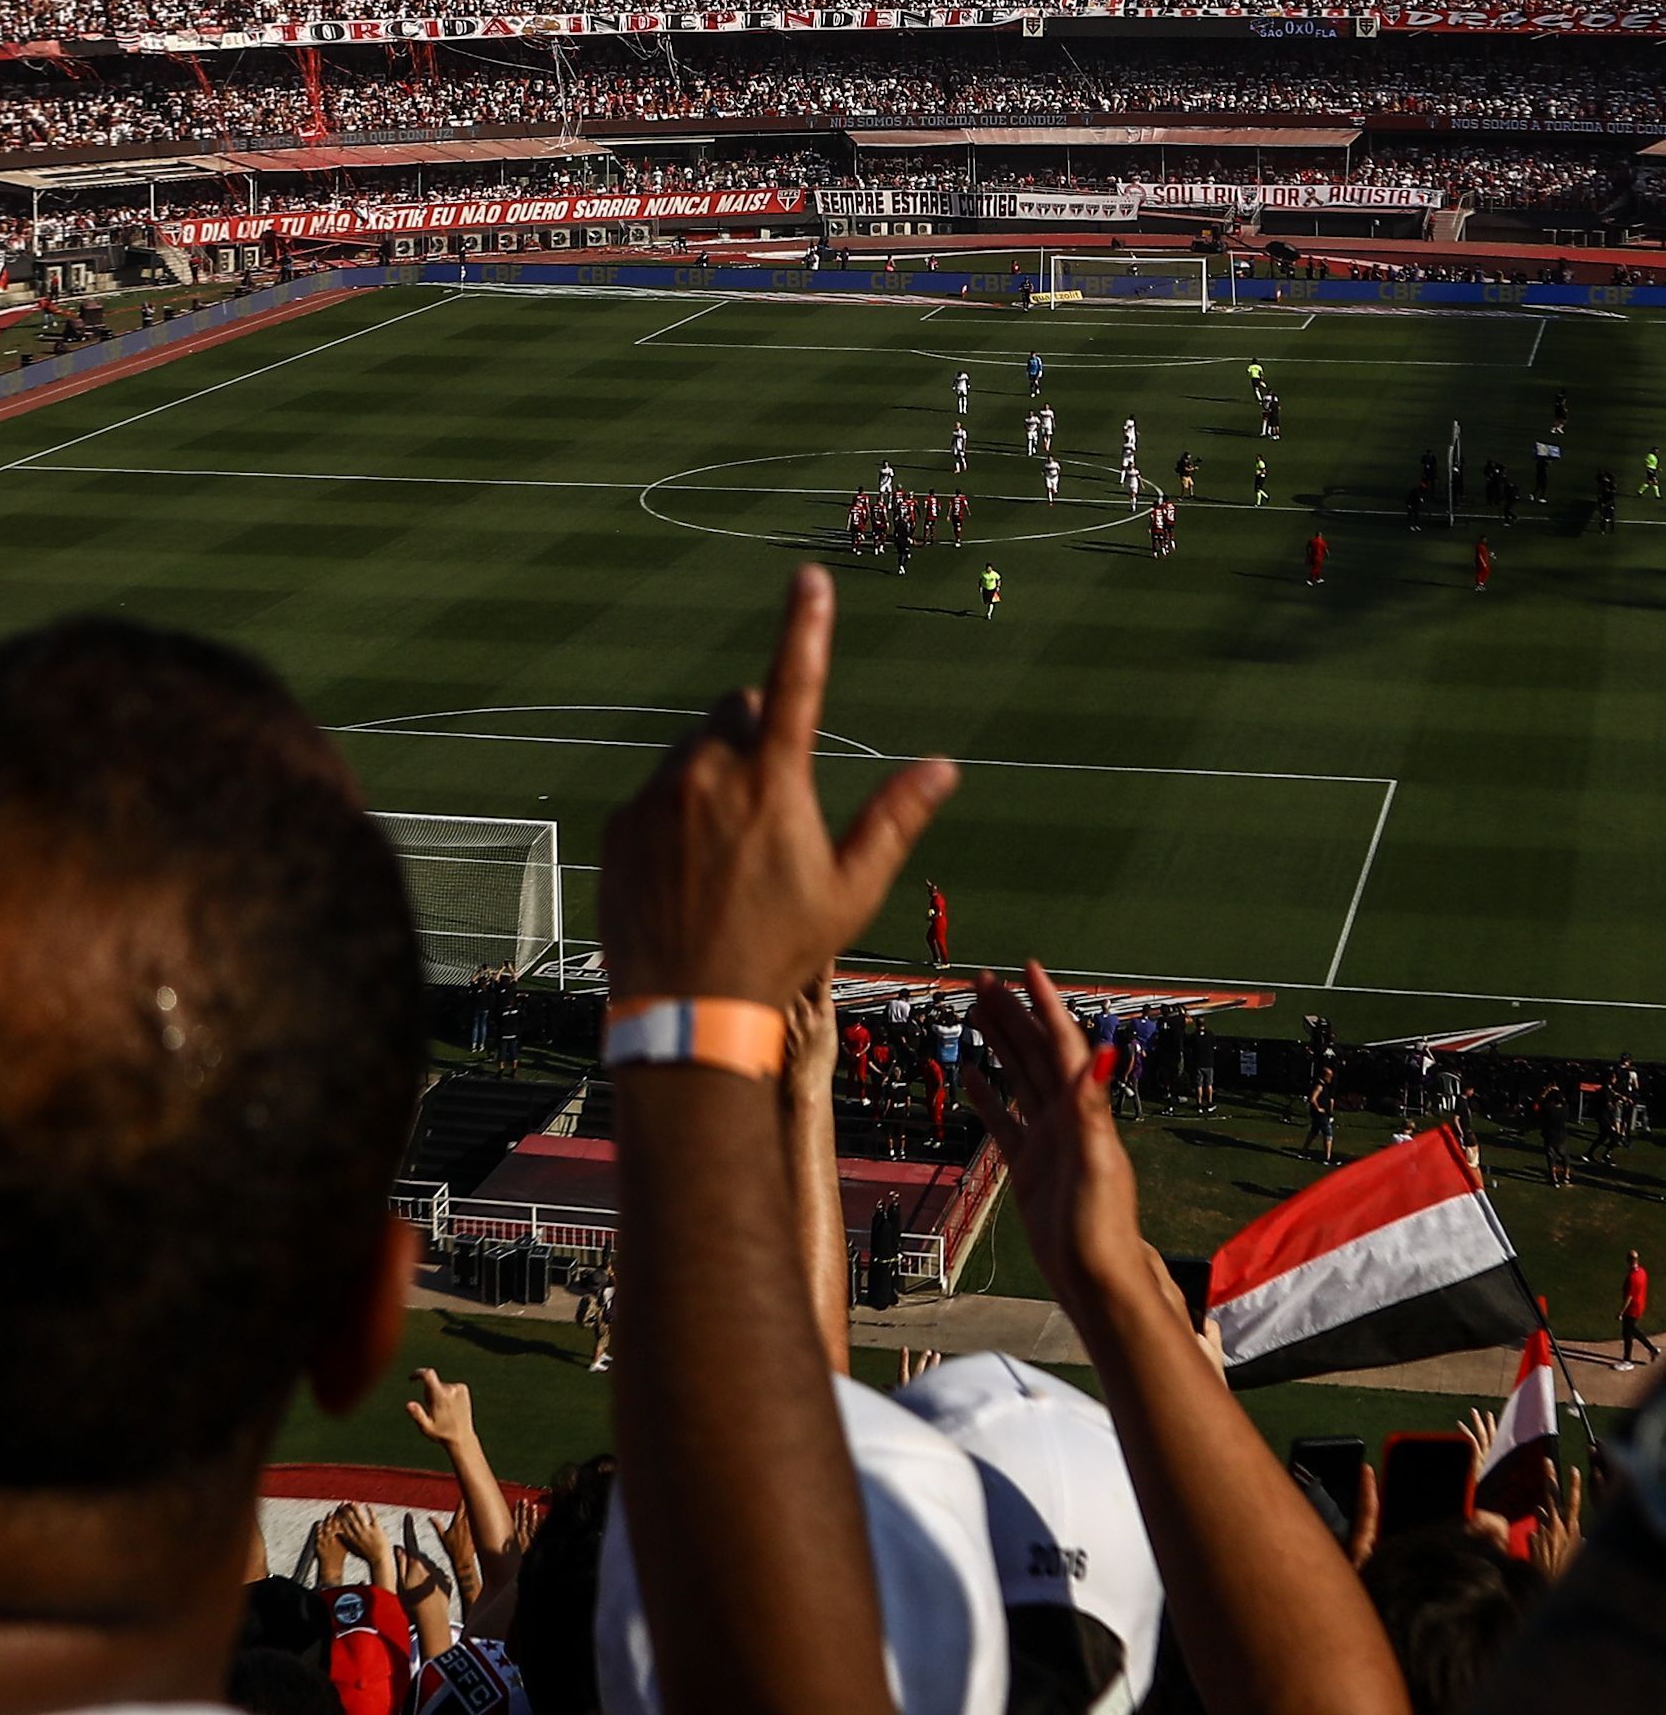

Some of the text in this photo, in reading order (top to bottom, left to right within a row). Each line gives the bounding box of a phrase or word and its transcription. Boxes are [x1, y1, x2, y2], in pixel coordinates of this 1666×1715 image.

[273, 18, 515, 41] TORCIDA
[1285, 20, 1315, 35] 0x0
[1315, 28, 1337, 38] FLA
[857, 116, 902, 128] SOMOS
[906, 116, 917, 127] A
[921, 115, 976, 127] TORCIDA
[980, 115, 1007, 127] QUE
[1010, 114, 1067, 127] CONDUZ!
[1482, 119, 1528, 131] SOMOS
[1532, 119, 1541, 131] A
[1544, 120, 1603, 133] TORCIDA
[1606, 122, 1634, 135] QUE
[820, 192, 1017, 216] SEMPRE ESTAREI CONTIGO
[1153, 187, 1193, 205] SOU
[1329, 186, 1411, 205] AUTISTA
[182, 224, 195, 244] O
[199, 221, 230, 243] DIA
[279, 216, 306, 236] TU
[432, 206, 455, 227] EU
[459, 201, 501, 225] NÃO
[506, 200, 566, 222] QUERO
[573, 197, 640, 218] SORRIR
[644, 195, 710, 216] NUNCA
[715, 191, 772, 213] MAIS!
[577, 267, 619, 285] CBF
[673, 267, 716, 285] CBF
[772, 271, 814, 288] CBF
[870, 272, 912, 290] CBF
[970, 273, 1012, 292] CBF
[1378, 282, 1424, 300] CBF
[1484, 285, 1529, 302] CBF
[1588, 286, 1634, 304] CBF
[439, 1648, 492, 1706] SPFC
